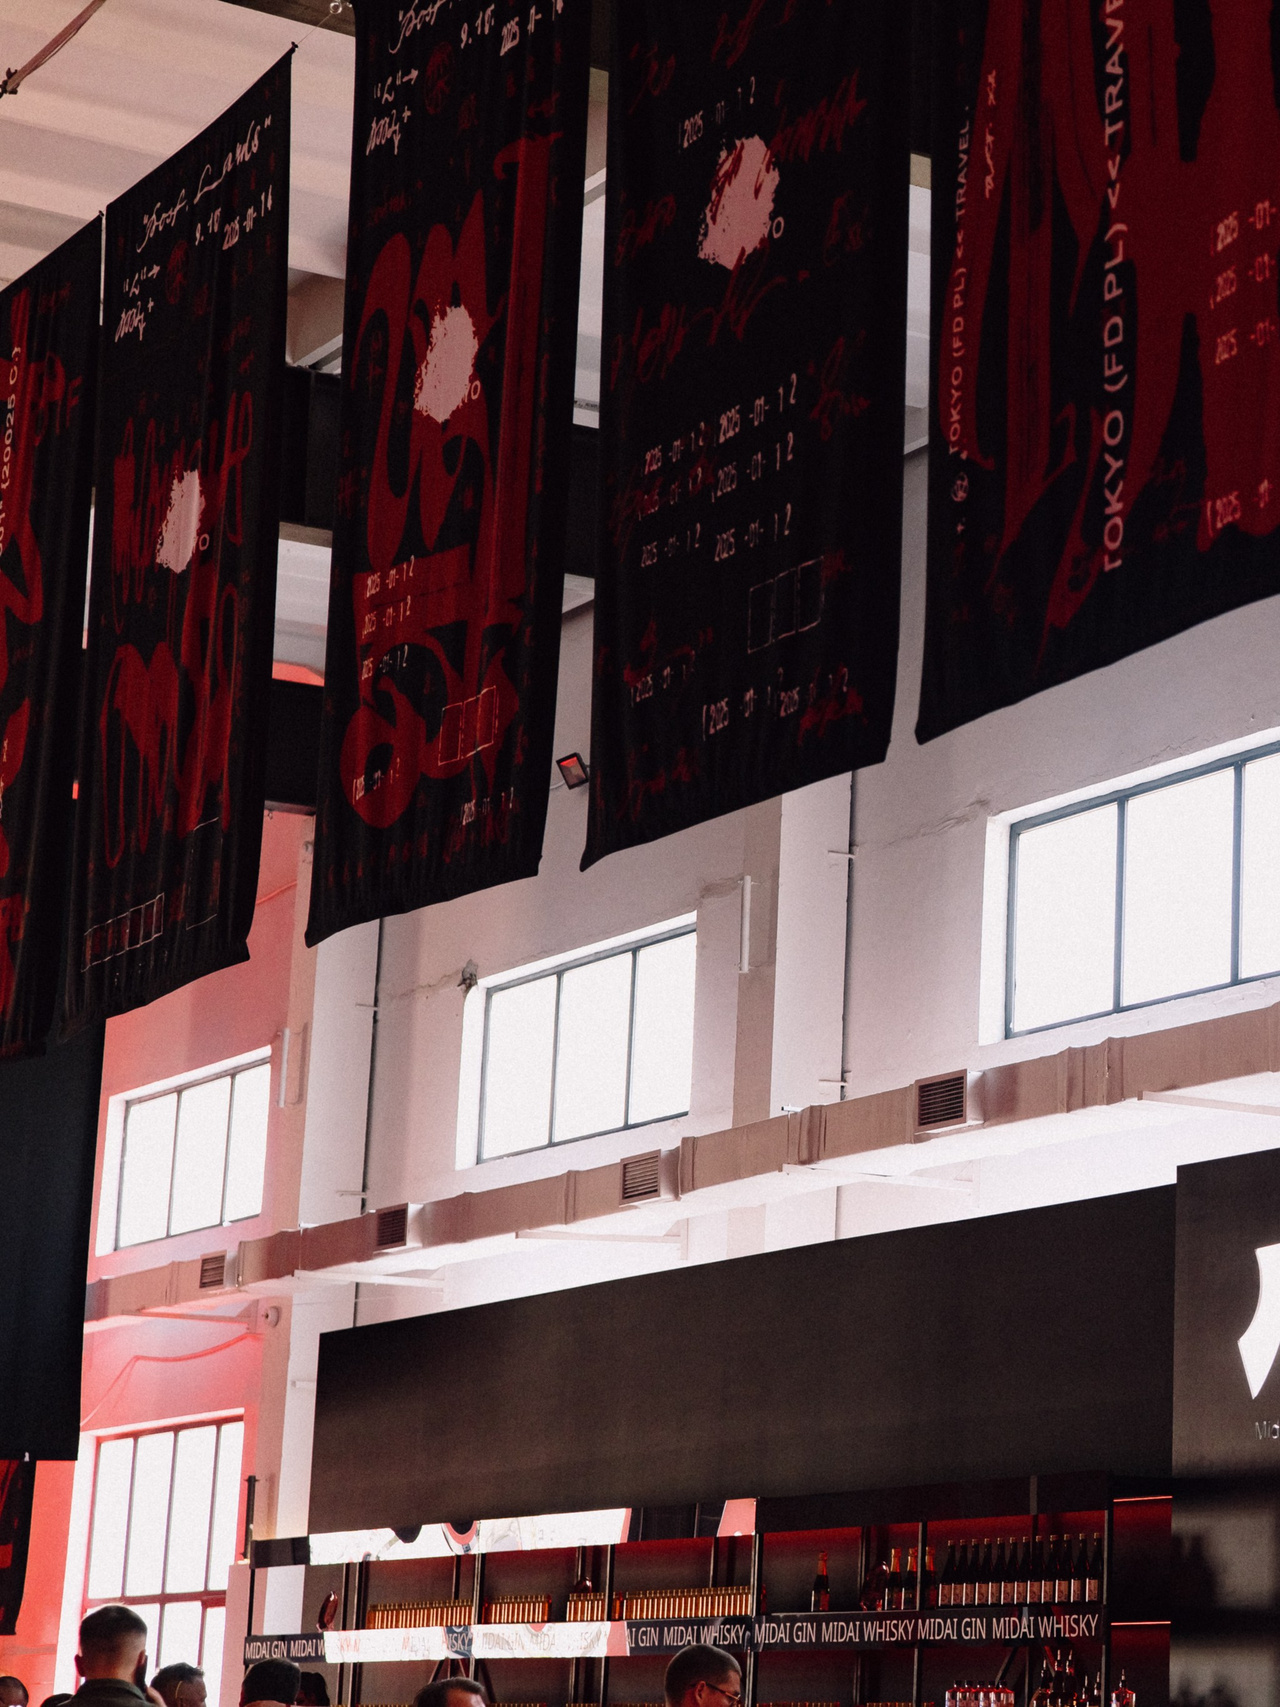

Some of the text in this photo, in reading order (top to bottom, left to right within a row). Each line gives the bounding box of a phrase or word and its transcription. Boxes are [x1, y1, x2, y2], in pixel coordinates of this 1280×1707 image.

[638, 1628, 658, 1647] GIN
[663, 1626, 697, 1646] MIDAI
[699, 1624, 746, 1645] WHISKY
[755, 1622, 791, 1644] MIDAI
[793, 1622, 817, 1643] GIN
[821, 1621, 860, 1643] MIDAI
[863, 1619, 915, 1642] WHISKY
[917, 1618, 958, 1641] MIDAI
[961, 1617, 986, 1640] GIN
[992, 1616, 1035, 1639] MIDAI
[1037, 1613, 1099, 1639] WHISKY
[245, 1641, 271, 1659] MIDAI
[271, 1640, 288, 1658] GIN
[290, 1639, 316, 1657] MIDAI
